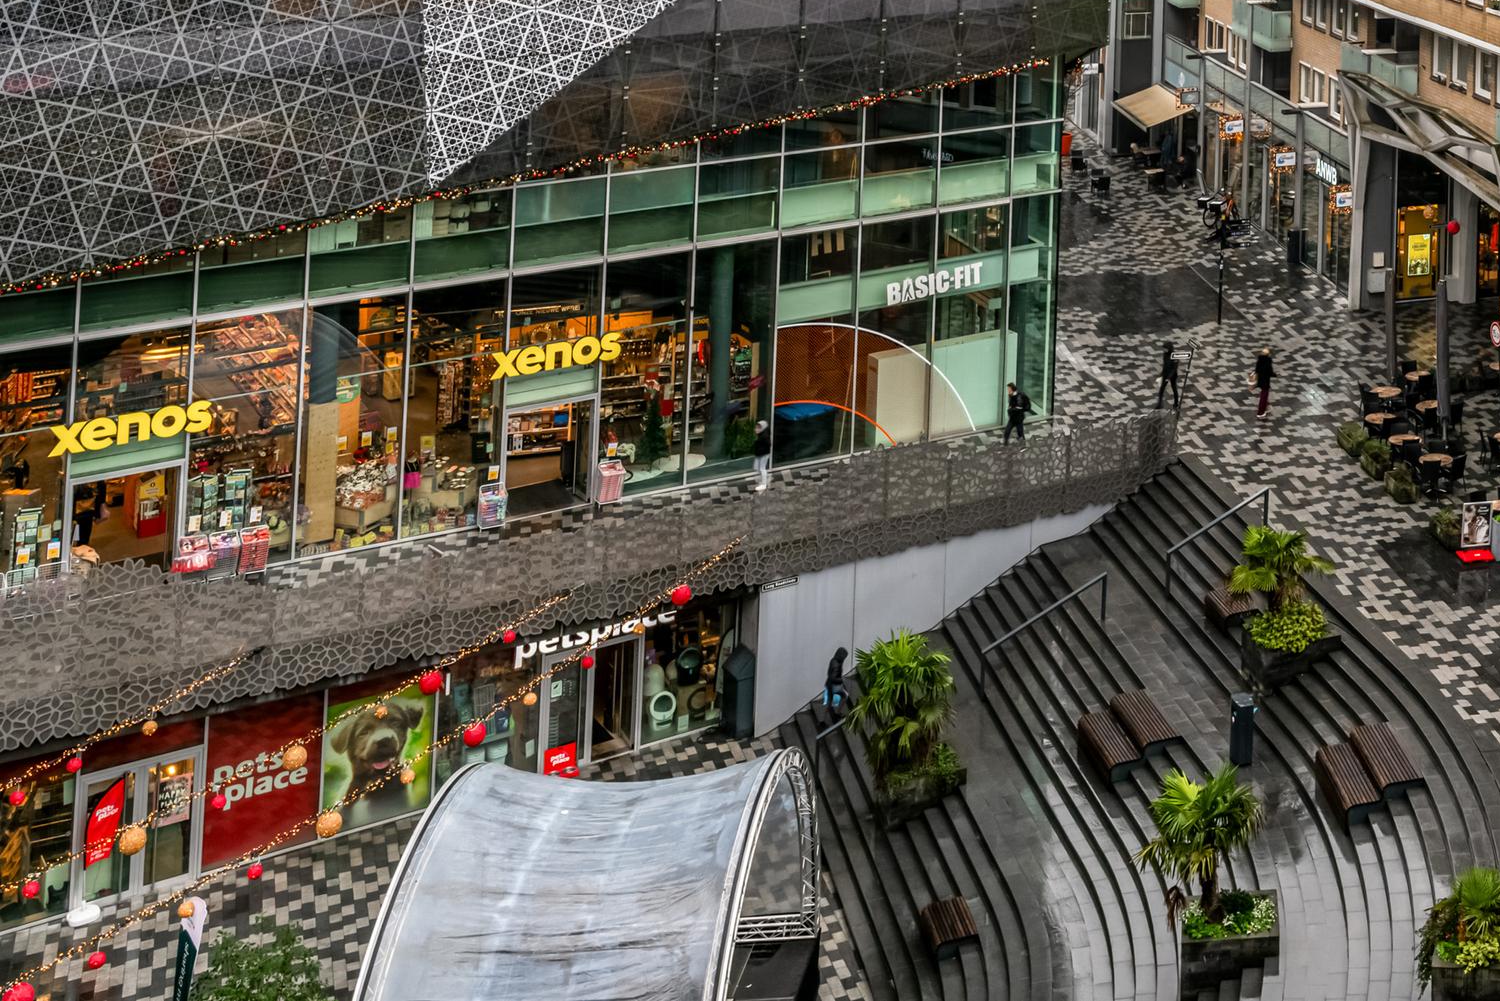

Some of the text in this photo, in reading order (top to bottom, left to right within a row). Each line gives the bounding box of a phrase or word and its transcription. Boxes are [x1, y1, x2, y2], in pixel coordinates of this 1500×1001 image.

[1315, 157, 1338, 186] ANWB
[490, 332, 622, 380] xenos
[47, 400, 213, 458] xenos
[212, 751, 284, 792] pets
[222, 766, 308, 811] place
